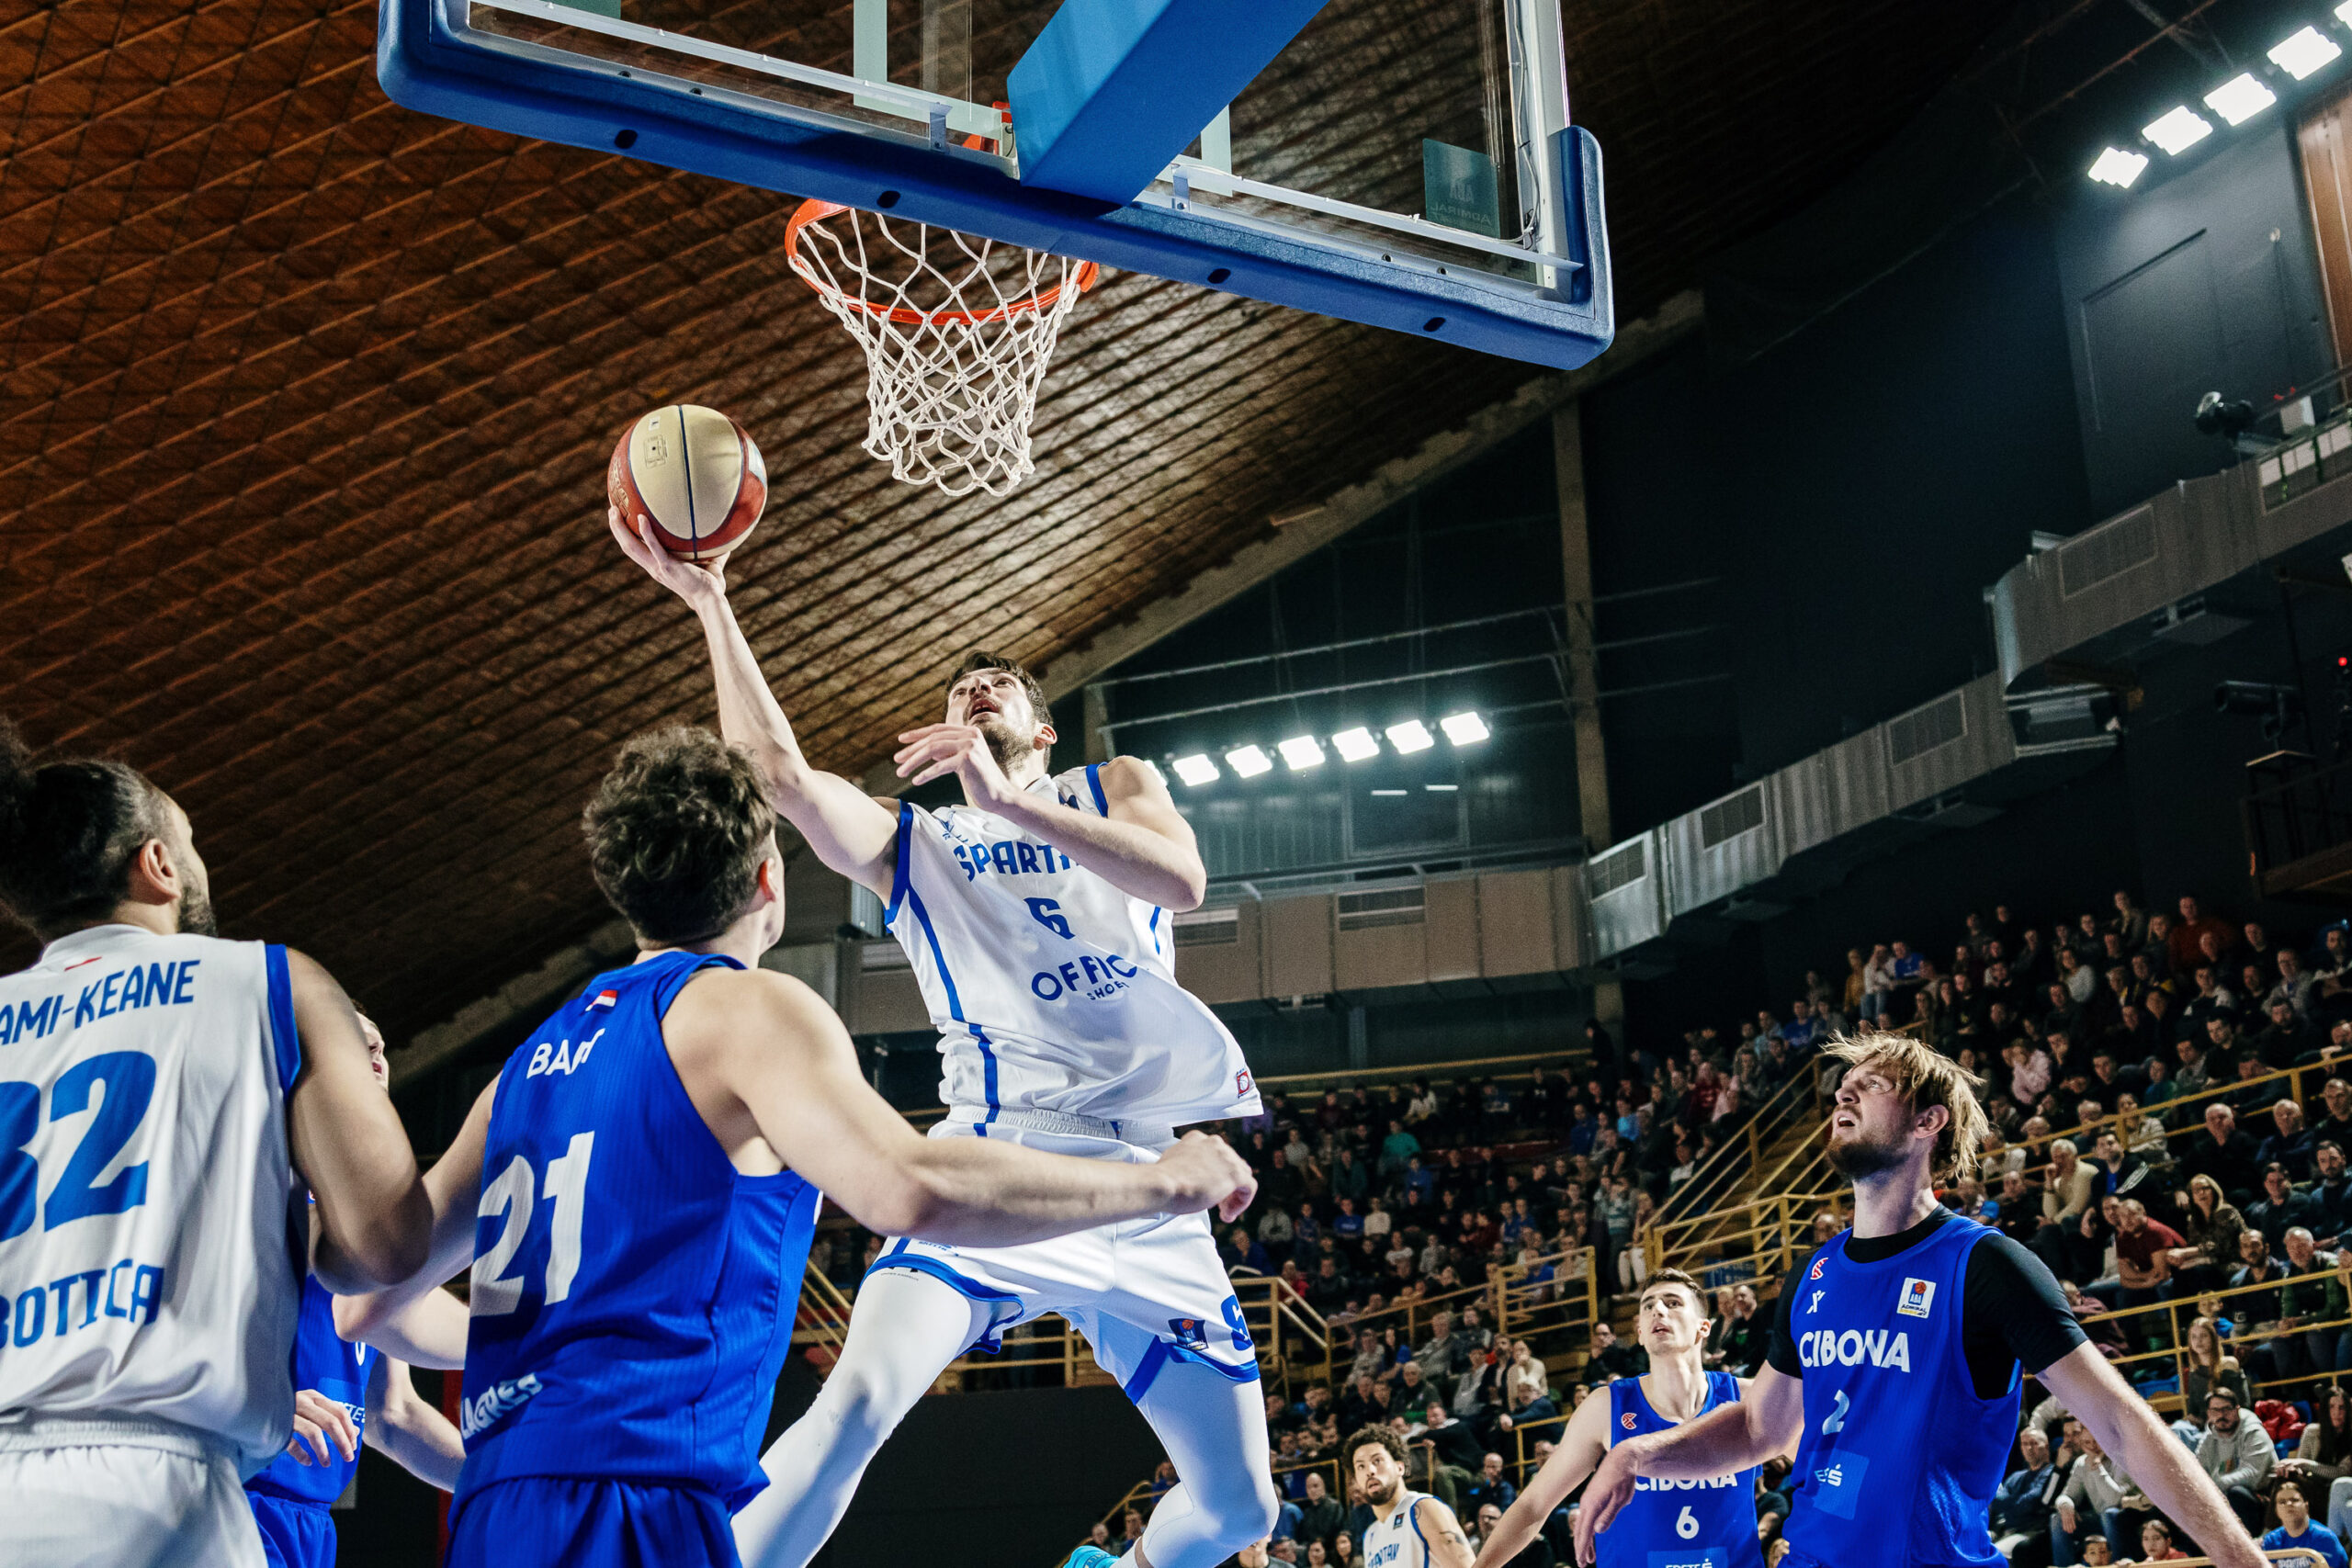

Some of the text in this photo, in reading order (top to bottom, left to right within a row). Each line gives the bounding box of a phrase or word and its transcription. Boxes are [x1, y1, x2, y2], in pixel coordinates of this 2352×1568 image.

[953, 840, 1080, 883] SPART
[1087, 981, 1130, 1000] SHOE
[469, 1131, 595, 1317] 21
[1799, 1328, 1911, 1373] CIBONA
[1822, 1389, 1850, 1436] 2
[1676, 1506, 1700, 1540] 6
